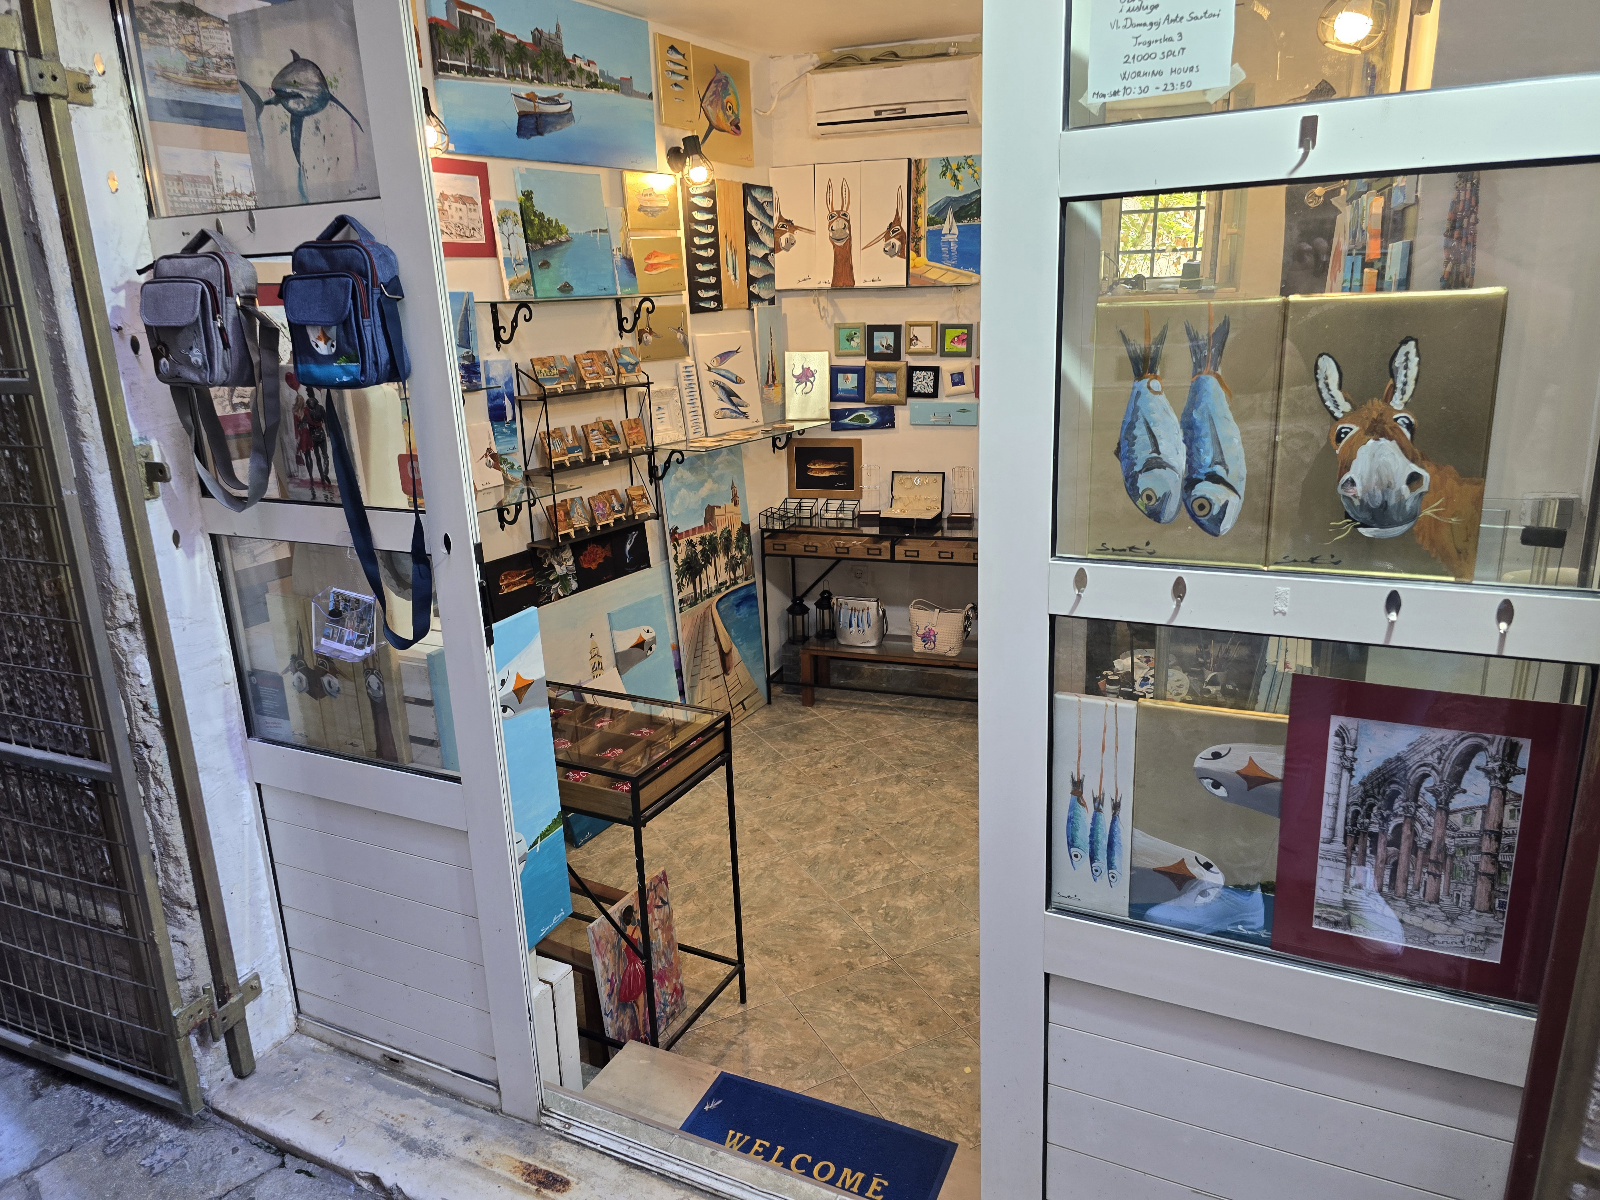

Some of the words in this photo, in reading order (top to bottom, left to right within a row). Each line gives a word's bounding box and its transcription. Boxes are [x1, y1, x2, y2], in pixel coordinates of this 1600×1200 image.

[1162, 13, 1184, 25] Ante
[1177, 31, 1183, 42] 3
[1123, 51, 1158, 64] 21000
[1159, 47, 1186, 60] SPLIT
[1170, 65, 1200, 76] HOURS
[1122, 85, 1150, 97] 10:30
[1162, 80, 1193, 92] 23:50
[724, 1129, 889, 1200] WELCOME
